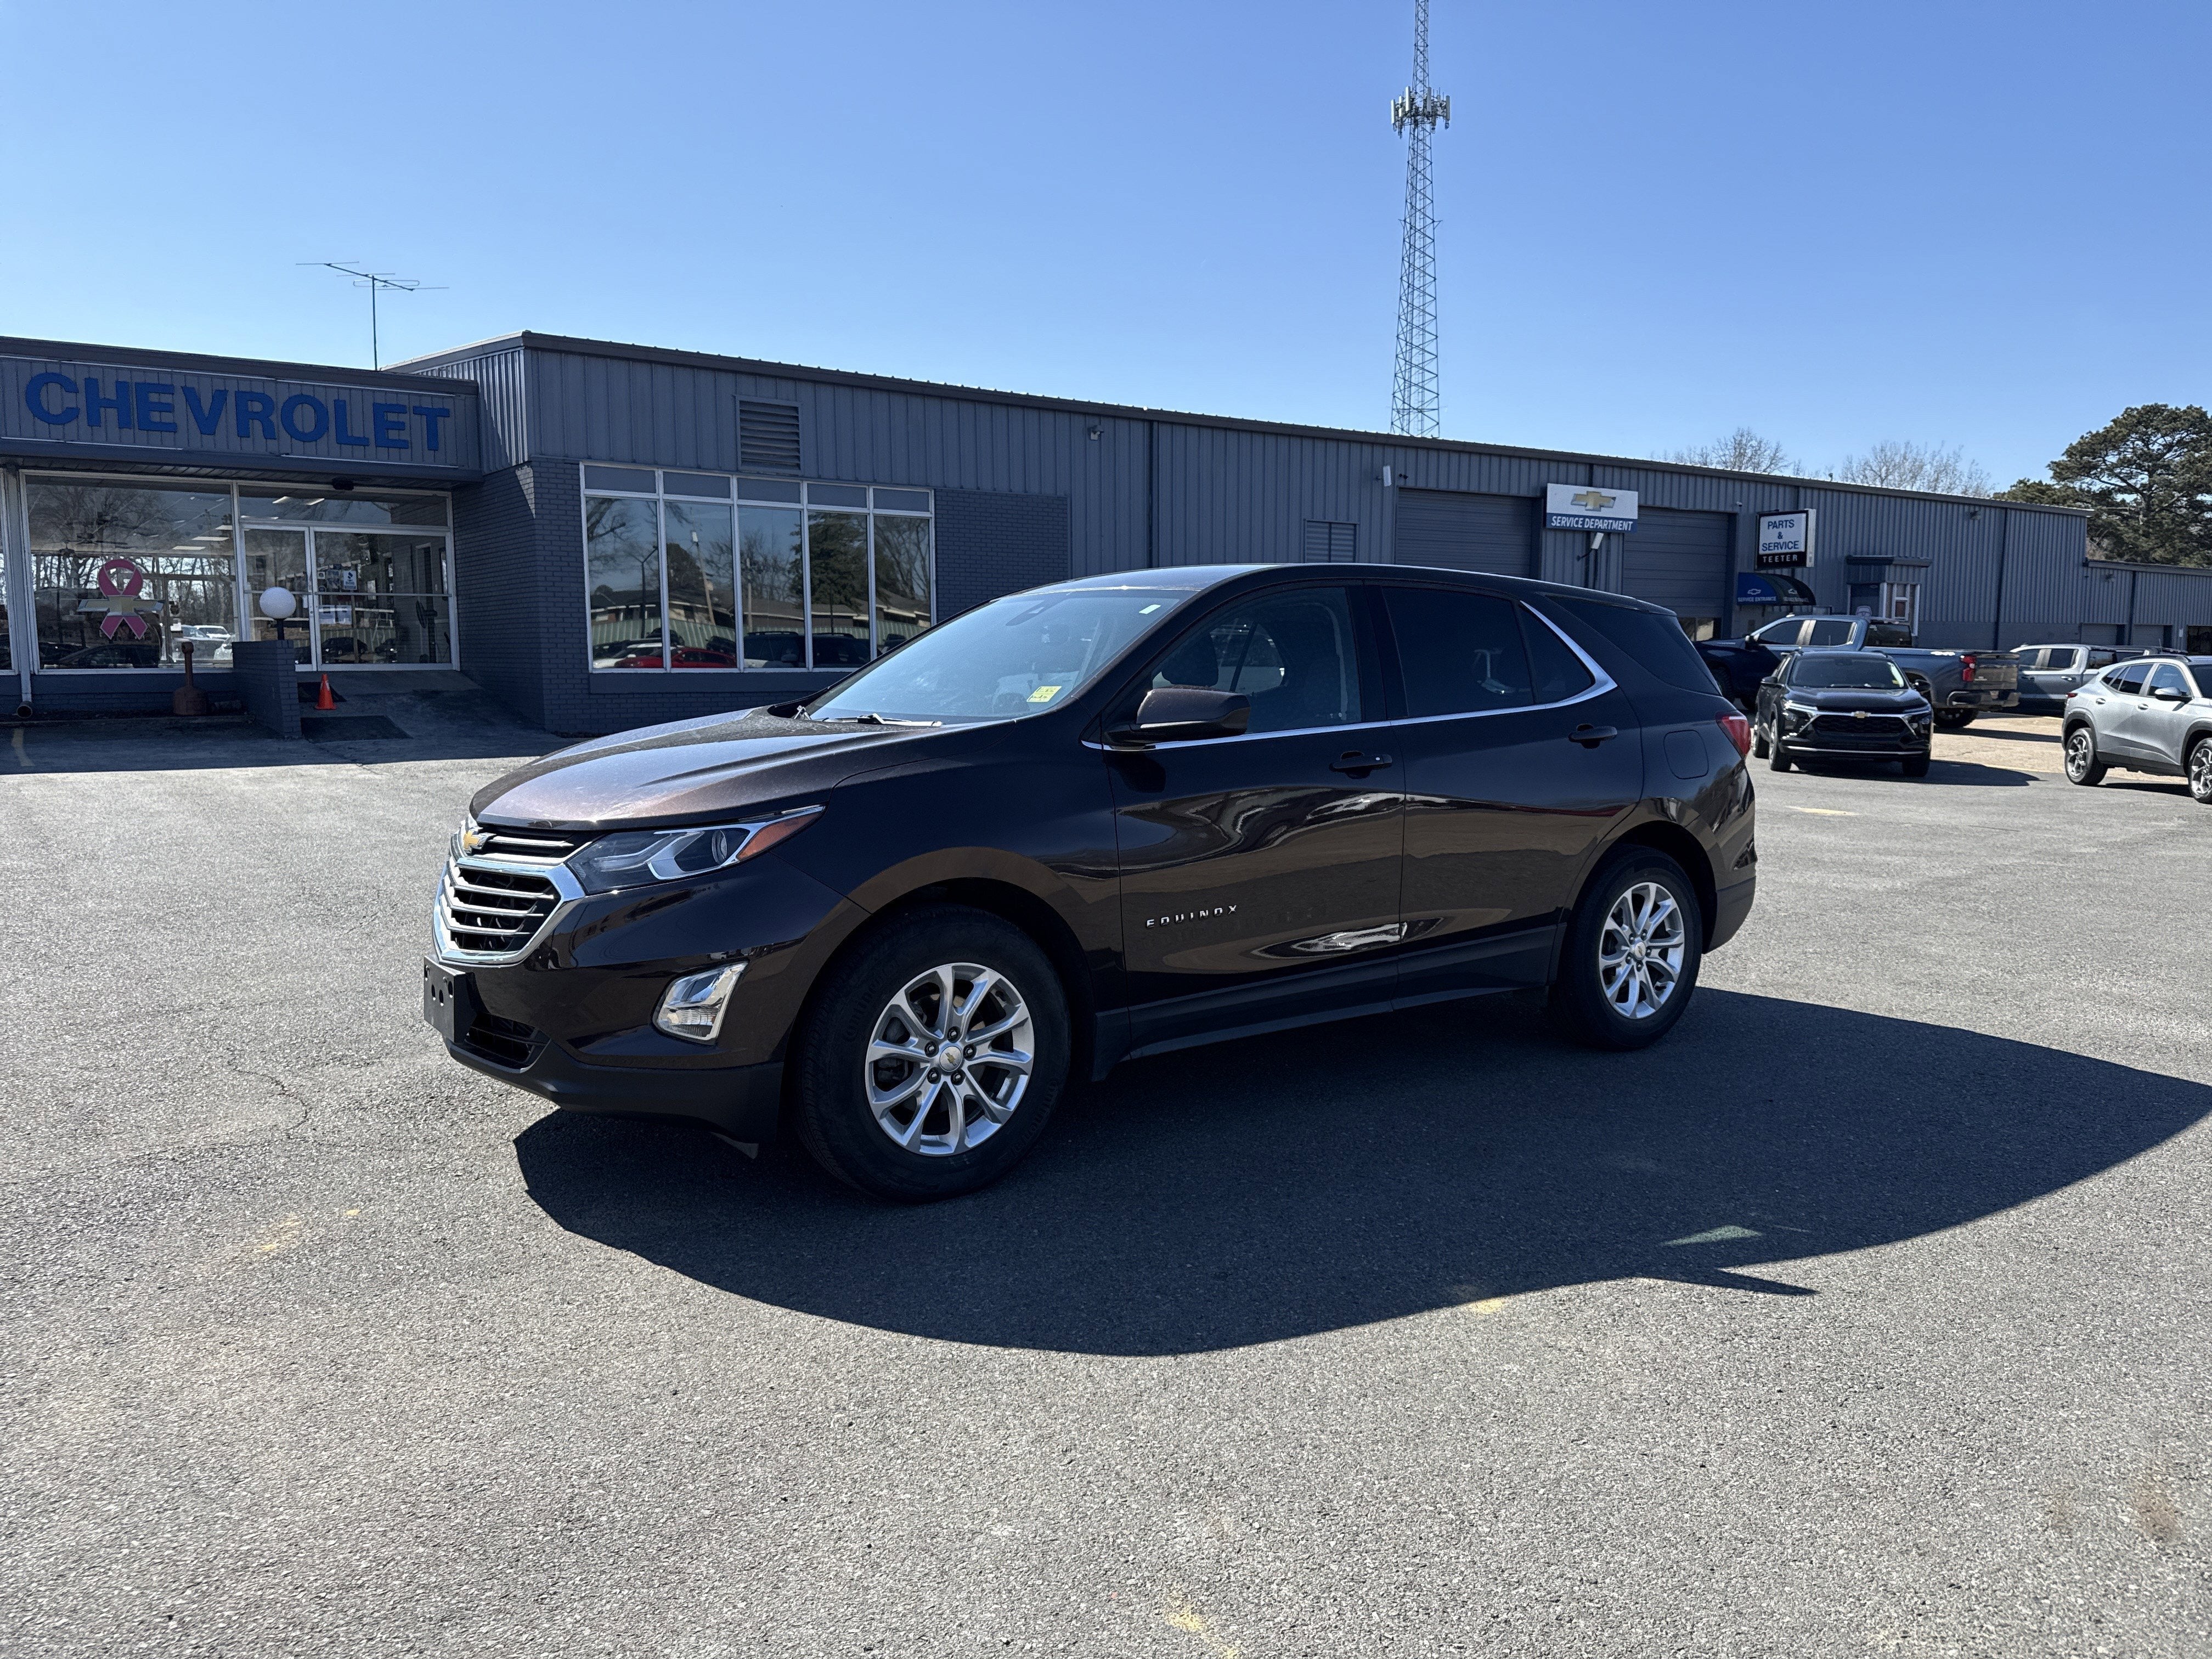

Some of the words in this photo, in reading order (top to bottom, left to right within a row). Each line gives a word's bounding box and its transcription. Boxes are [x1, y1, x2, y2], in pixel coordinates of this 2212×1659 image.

[25, 372, 450, 451] CHEVROLET
[1551, 516, 1584, 528] SERVICE
[1584, 518, 1633, 531] DEPARTMENT
[1767, 519, 1795, 530] PARTS
[1762, 540, 1799, 551] SERVICE
[1763, 554, 1798, 563] TEETER
[1146, 905, 1237, 928] EQUINOX
